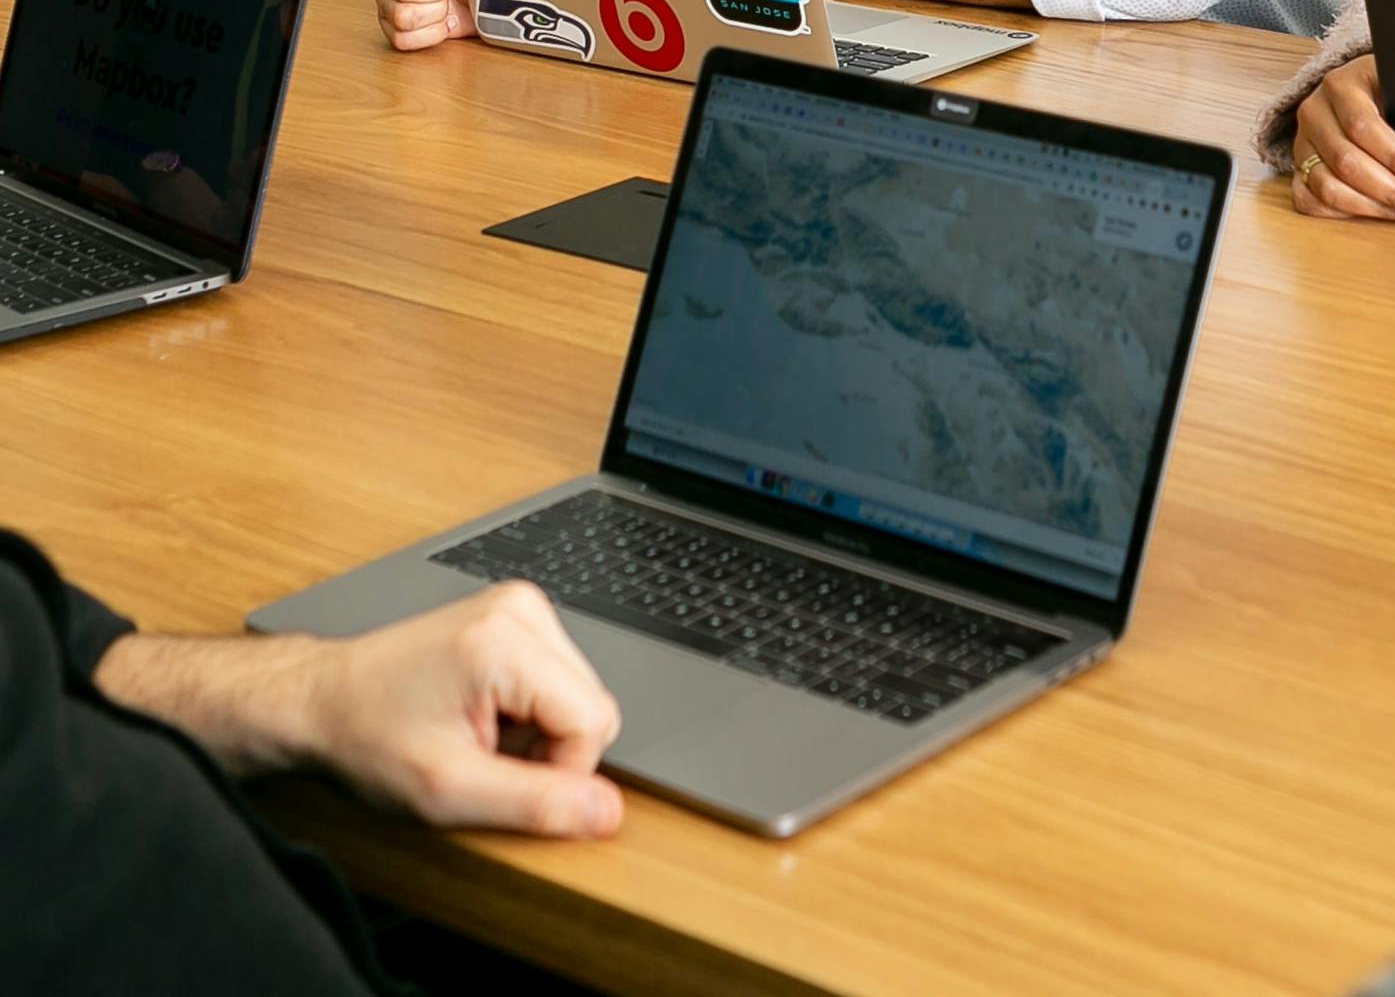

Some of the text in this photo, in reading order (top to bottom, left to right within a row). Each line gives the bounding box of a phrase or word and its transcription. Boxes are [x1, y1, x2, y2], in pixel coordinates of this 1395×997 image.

[719, 0, 791, 19] SAN JOSE
[174, 10, 225, 54] use
[72, 38, 198, 116] Mapbox?
